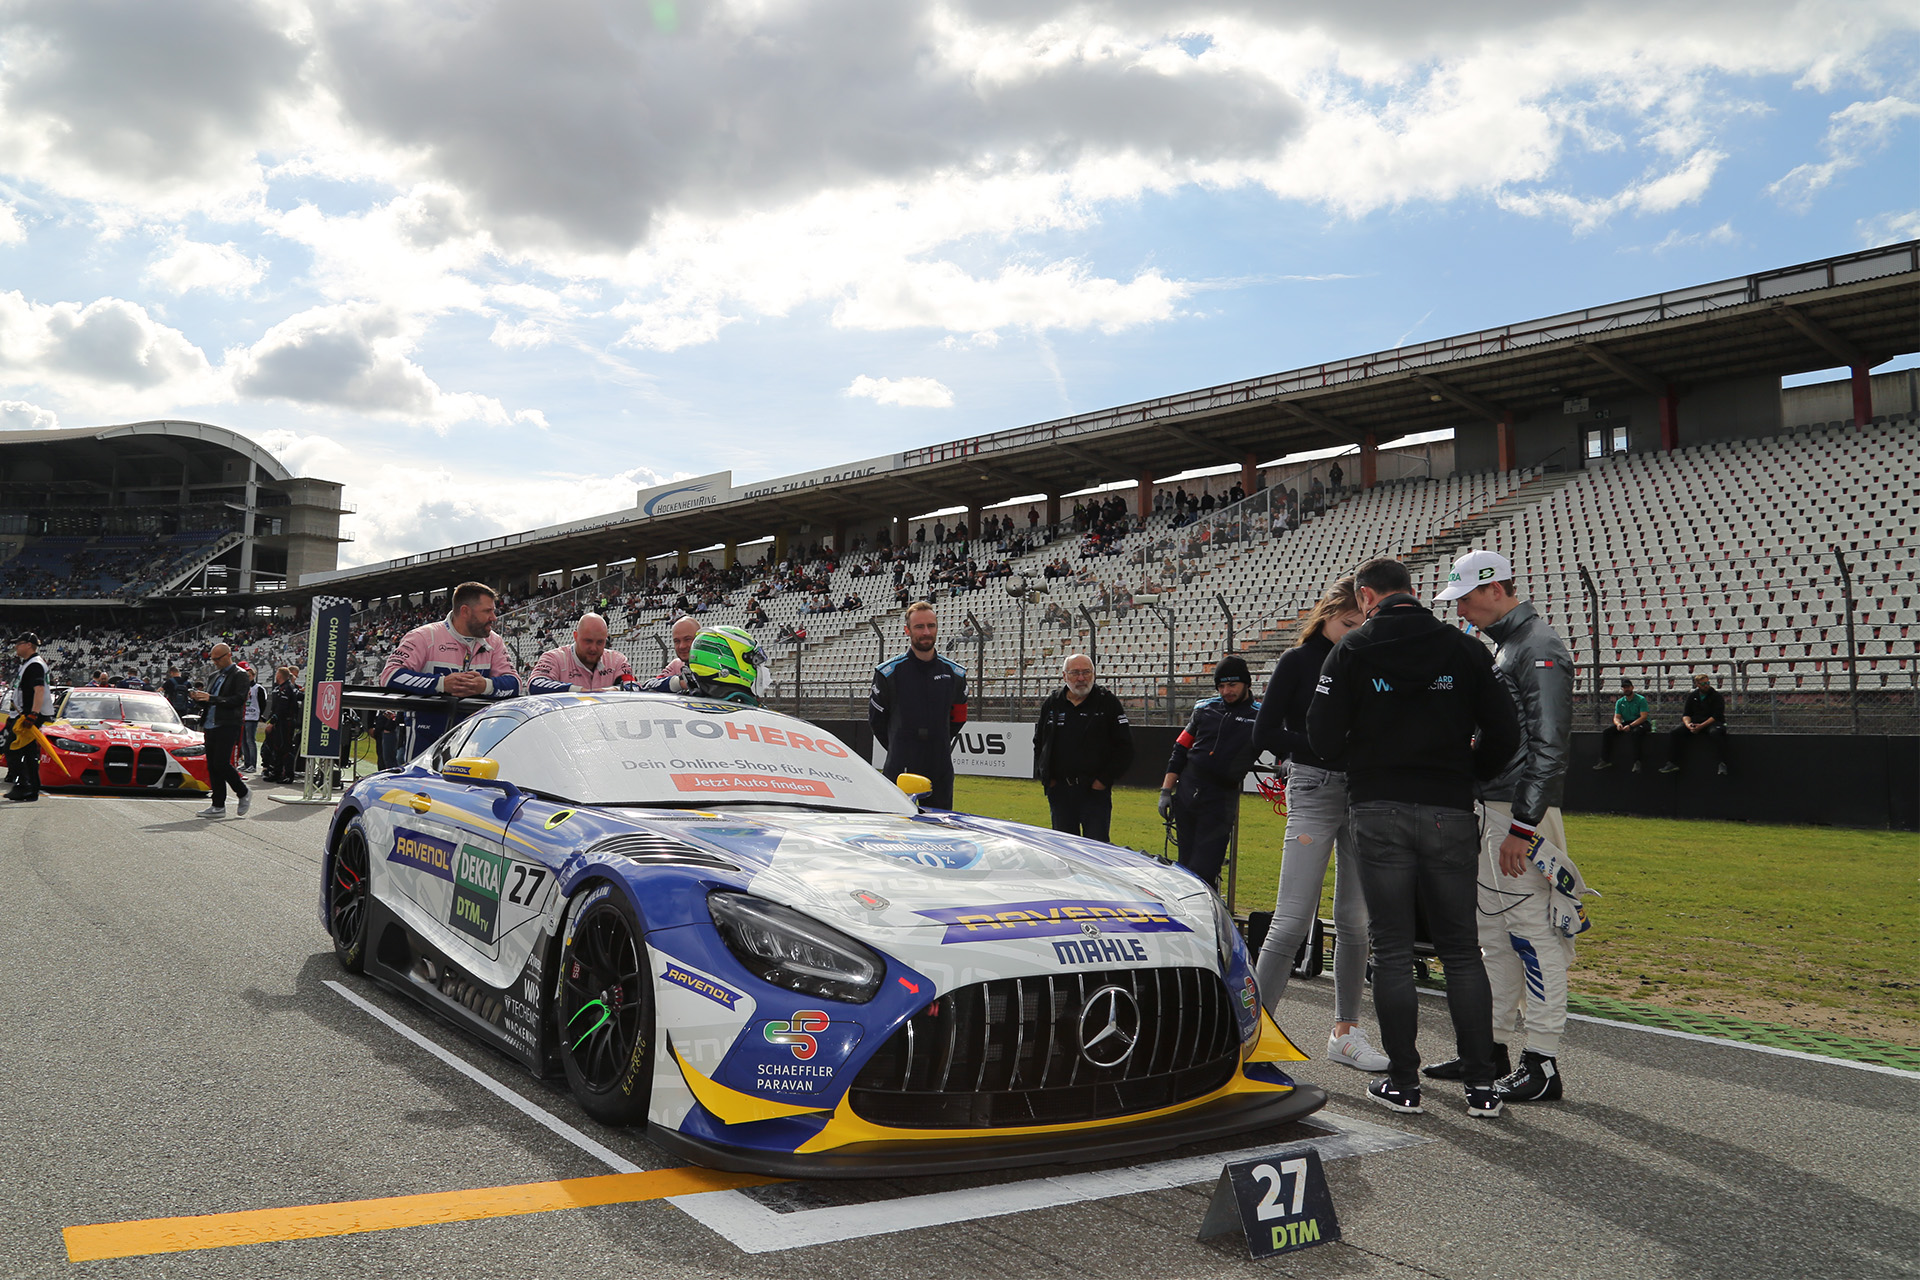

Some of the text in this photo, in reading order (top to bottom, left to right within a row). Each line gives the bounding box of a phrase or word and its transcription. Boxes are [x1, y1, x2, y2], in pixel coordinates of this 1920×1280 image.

[621, 758, 853, 784] Dein Online-Shop für Autos
[952, 758, 1006, 768] PORT EXHAUSTS
[694, 777, 815, 792] Jetzt Auto finden
[396, 836, 451, 871] RAVENOL
[858, 841, 956, 852] Krombacher
[460, 852, 499, 894] DEKRA
[508, 865, 547, 907] 27
[456, 896, 489, 933] DTM TV
[1051, 938, 1148, 965] MAHLE
[668, 968, 734, 1004] RAVENOL
[757, 1064, 833, 1077] SCHAEFFLER
[757, 1079, 813, 1091] PARAVAN
[1250, 1157, 1309, 1222] 27
[1270, 1218, 1321, 1250] DTM
